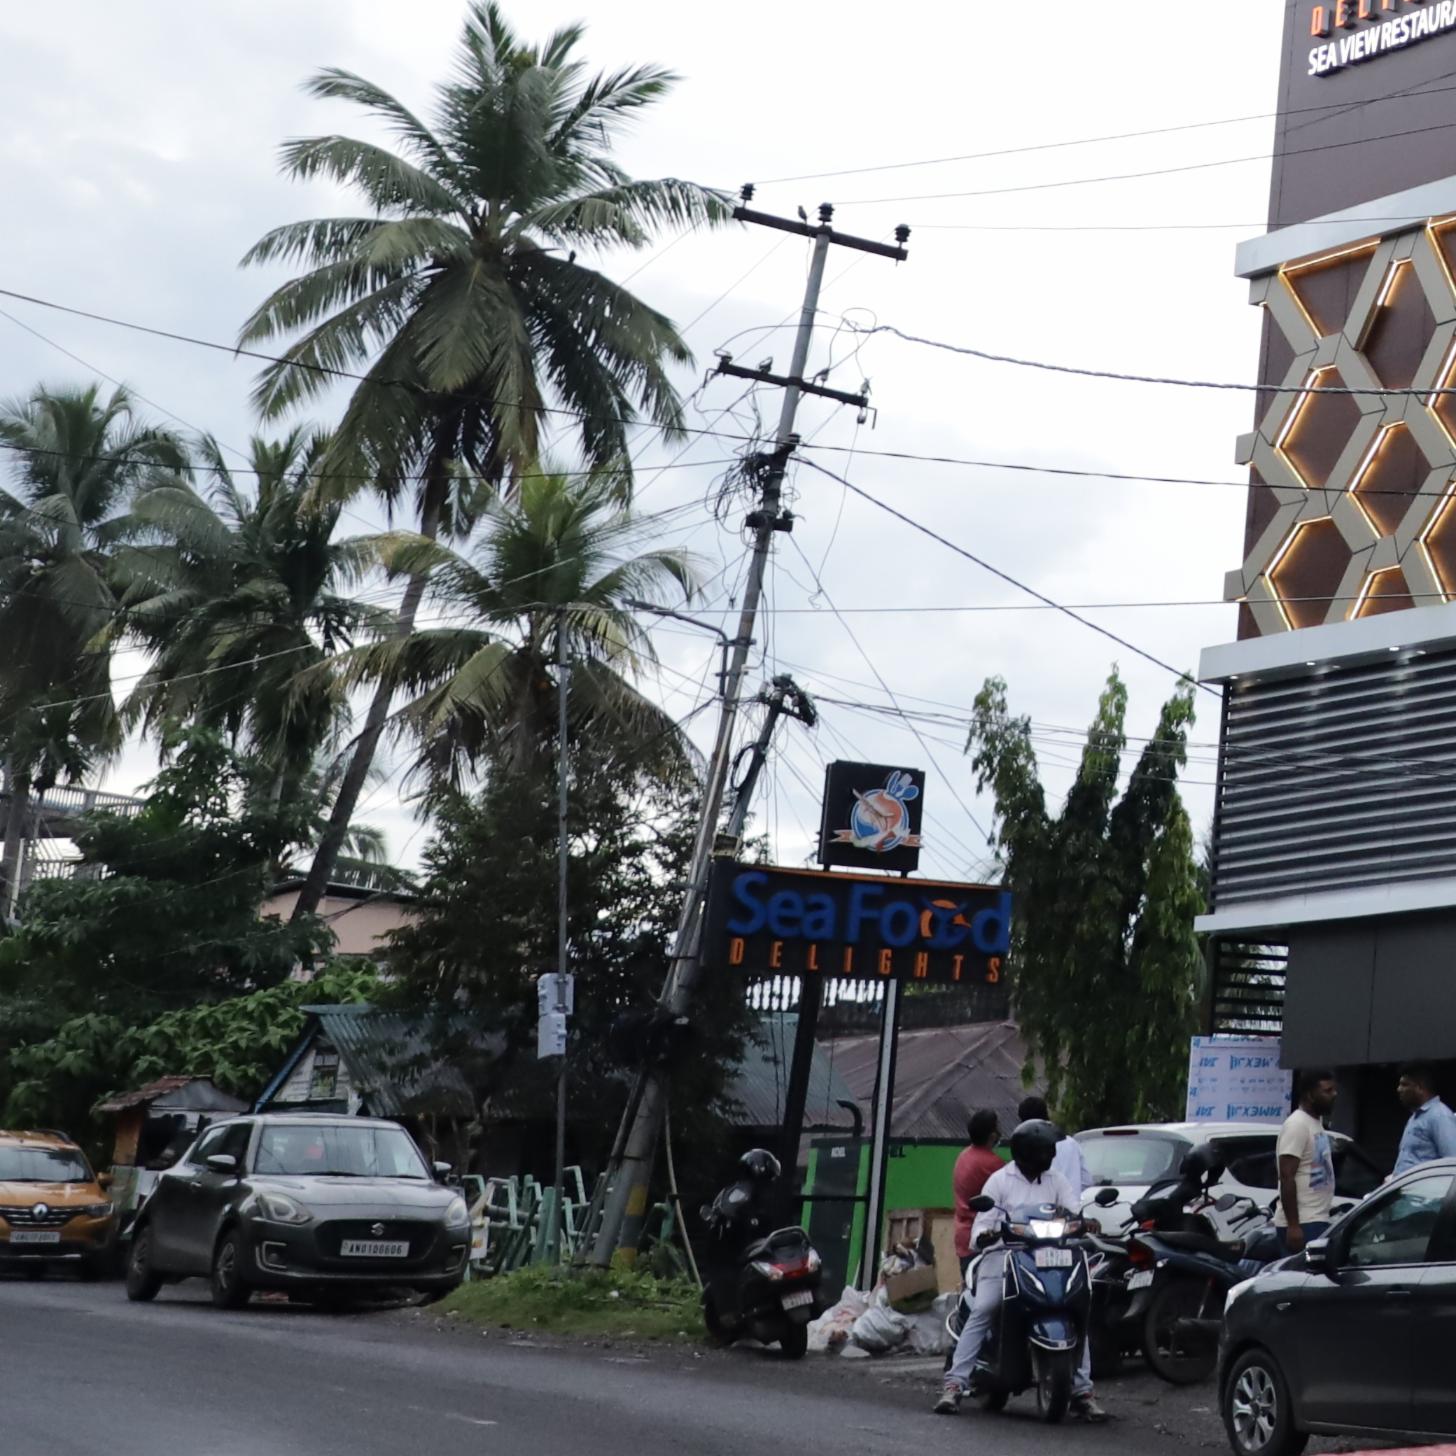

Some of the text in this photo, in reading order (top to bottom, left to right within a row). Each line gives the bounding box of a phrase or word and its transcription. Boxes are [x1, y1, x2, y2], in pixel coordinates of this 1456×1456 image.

[1308, 42, 1338, 76] SEA
[1340, 25, 1382, 64] VIEW
[726, 870, 1013, 954] Sea Food
[728, 936, 1001, 984] DELIGHTS
